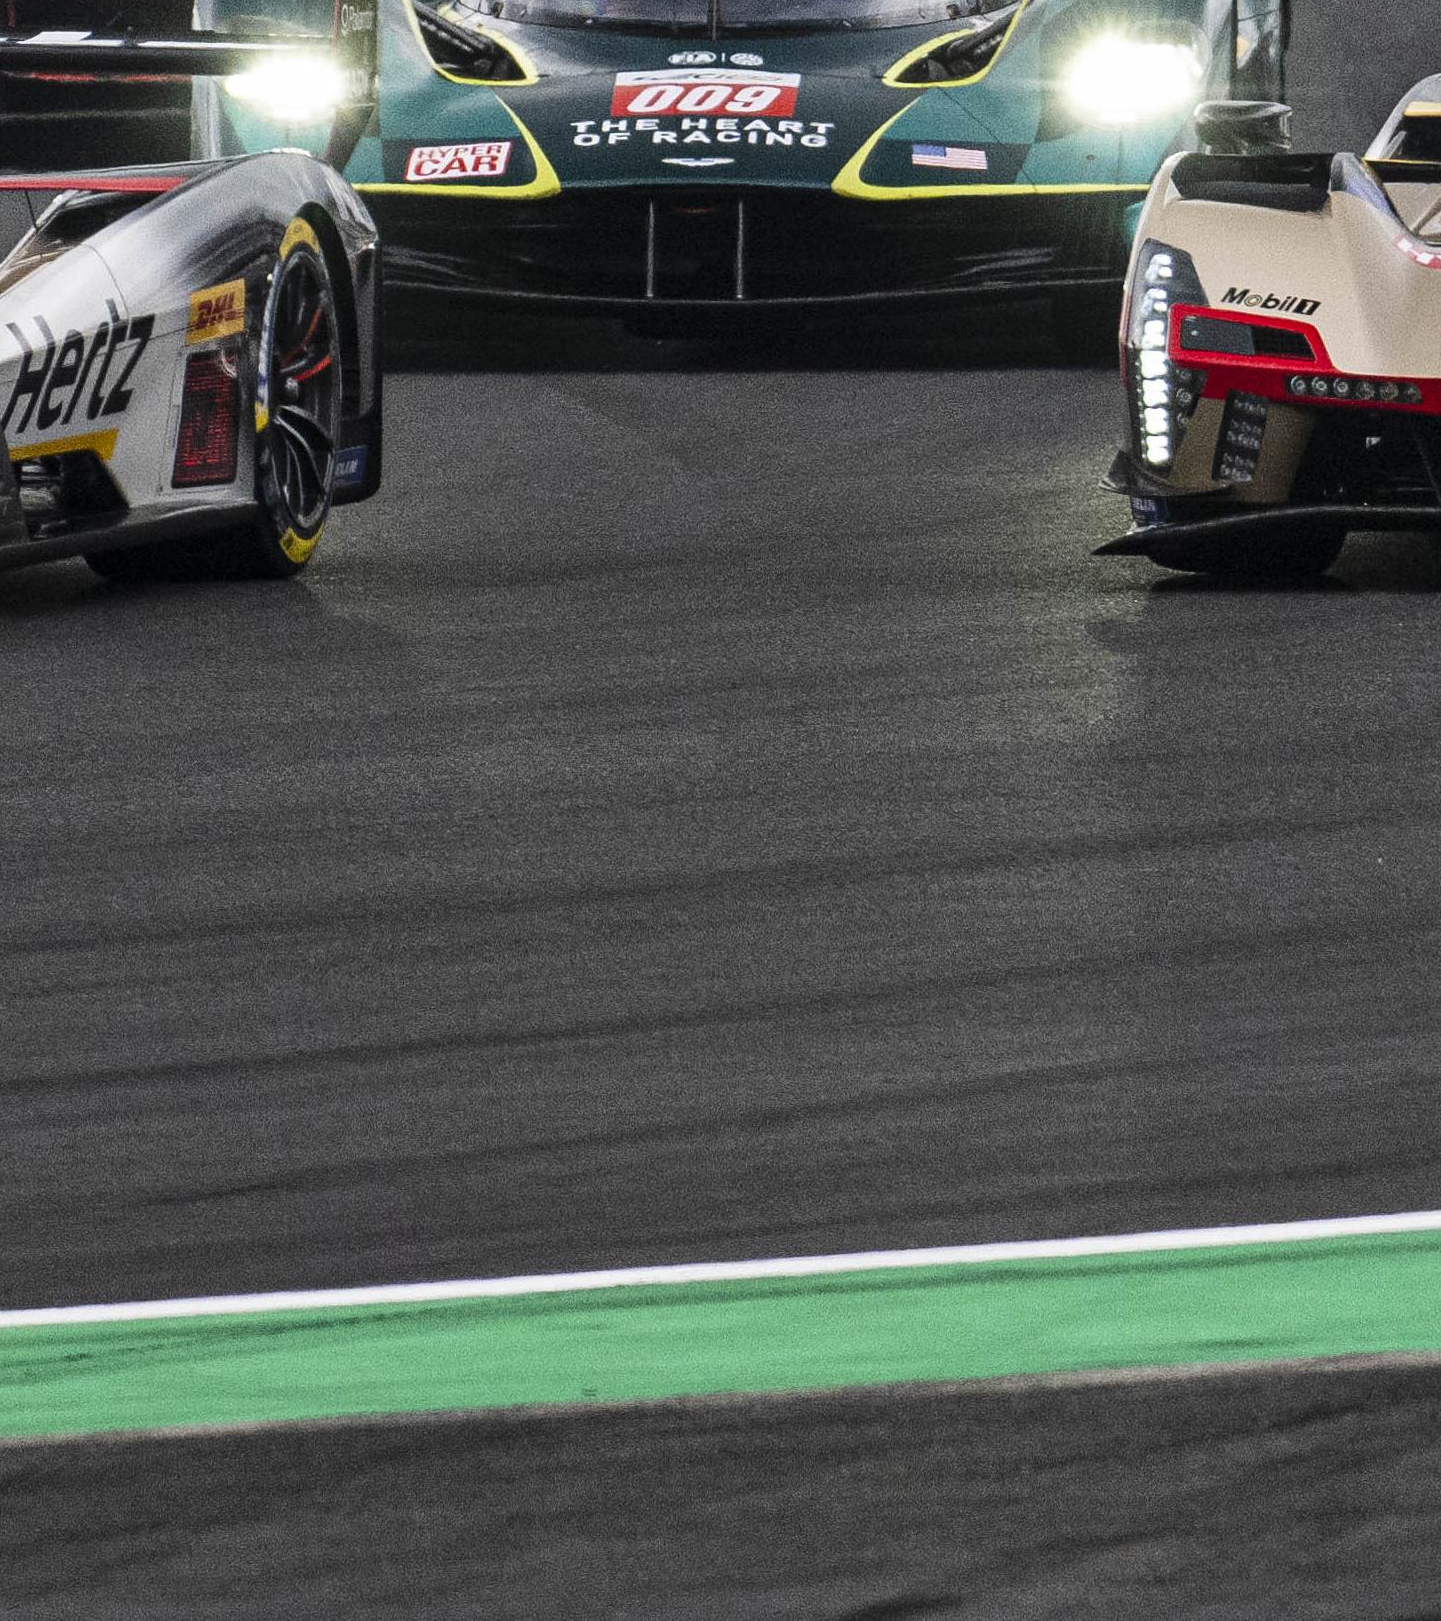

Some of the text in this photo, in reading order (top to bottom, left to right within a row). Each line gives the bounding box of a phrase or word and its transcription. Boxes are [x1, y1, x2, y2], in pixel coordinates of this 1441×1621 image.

[626, 85, 781, 113] 009
[570, 118, 836, 135] THE HEART
[573, 130, 829, 148] OF RACING
[416, 144, 504, 161] HYPER
[413, 154, 504, 177] CAR
[1221, 286, 1297, 314] Mobil
[5, 299, 155, 433] Hertz
